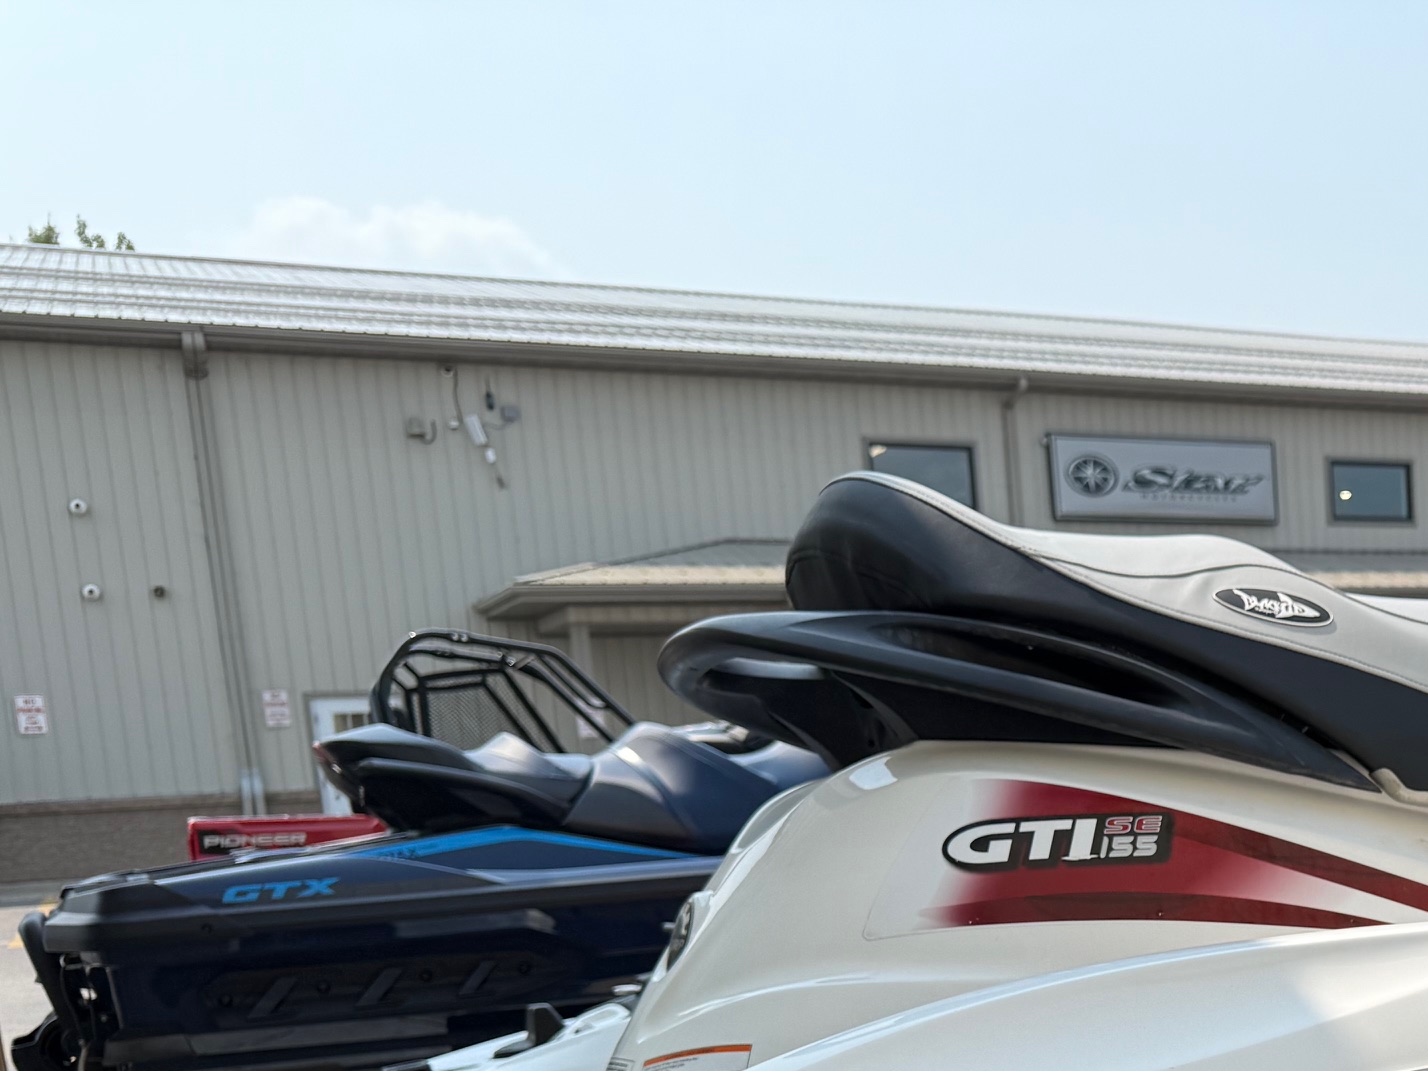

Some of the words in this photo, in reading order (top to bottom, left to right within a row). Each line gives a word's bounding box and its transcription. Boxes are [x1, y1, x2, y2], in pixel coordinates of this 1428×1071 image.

[203, 832, 308, 849] PIONEER
[947, 818, 1099, 864] GTI
[1104, 815, 1163, 834] SE
[1100, 835, 1159, 859] 155
[222, 877, 341, 904] GTX
